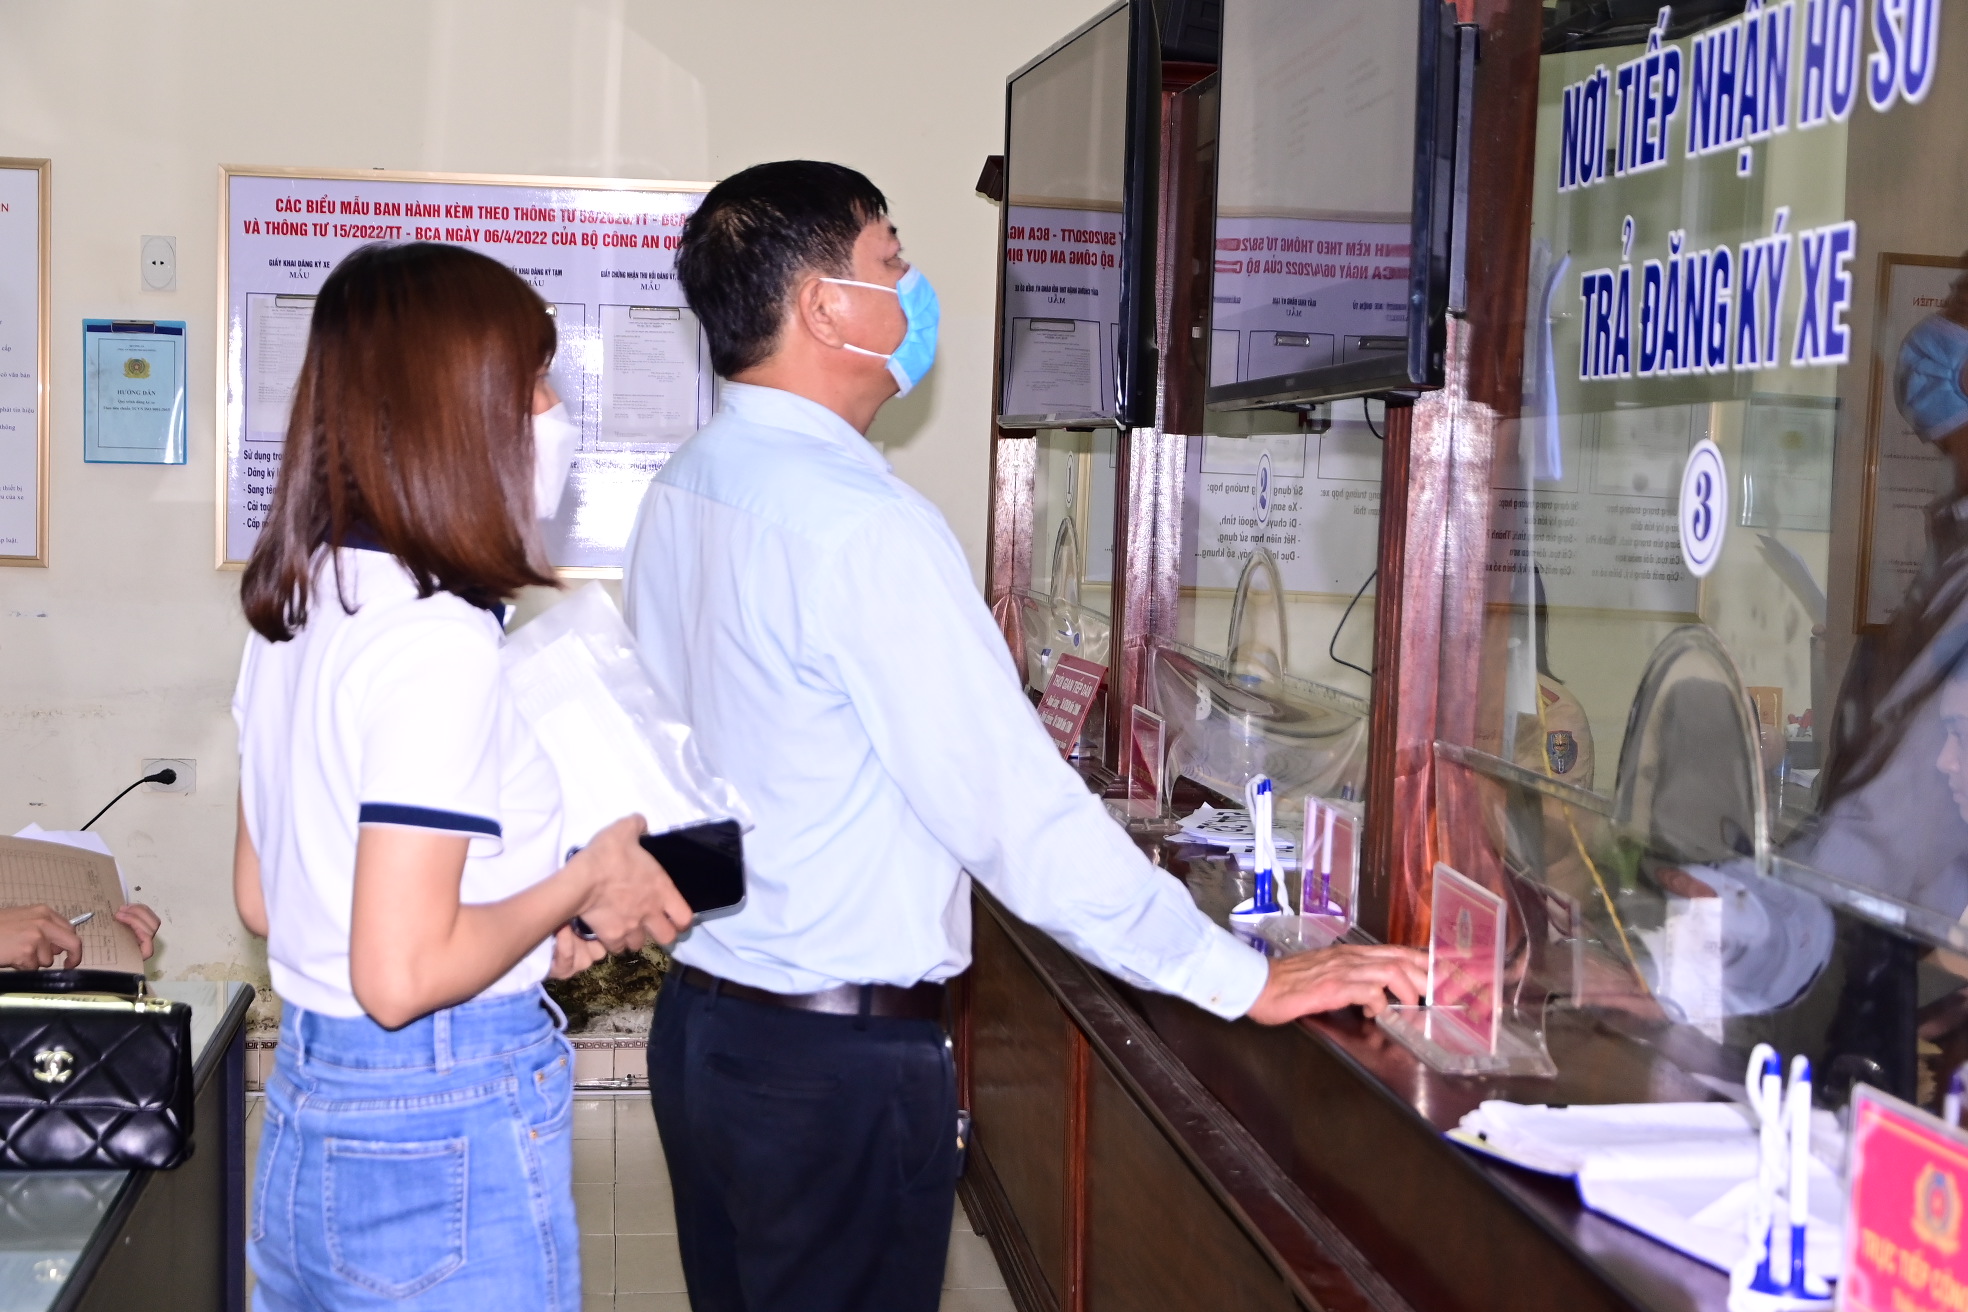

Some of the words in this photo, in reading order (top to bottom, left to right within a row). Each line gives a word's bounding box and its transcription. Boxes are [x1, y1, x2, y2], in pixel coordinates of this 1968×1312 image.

[1558, 63, 1611, 192] NƠI
[1615, 5, 1683, 178] TIẾP
[1685, 0, 1795, 178] NHẬN
[276, 196, 302, 213] CÁC
[306, 194, 336, 214] BIỂU
[340, 195, 370, 216] MẪU
[374, 201, 401, 217] BAN
[405, 200, 440, 218] HÀNH
[445, 201, 474, 219] KÈM
[477, 206, 510, 221] THEO
[513, 205, 556, 222] THÔNG
[560, 207, 576, 223] TƯ
[244, 219, 261, 235] VÀ
[264, 218, 308, 237] THÔNG
[311, 221, 330, 238] TƯ
[332, 223, 403, 240] 15/2022/TT
[415, 226, 442, 241] BCA
[445, 227, 480, 243] NGÀY
[484, 228, 548, 245] 06/4/2022
[551, 226, 577, 246] CỦA
[581, 230, 599, 249] BỘ
[602, 230, 637, 248] CÔNG
[641, 234, 660, 249] AN
[663, 235, 685, 251] QU
[283, 259, 296, 268] KHAI
[323, 261, 330, 269] XE
[518, 267, 530, 275] KHAI
[289, 269, 310, 279] MẪU
[640, 280, 661, 290] MẪU
[1579, 214, 1633, 381] TRẢ
[1637, 228, 1733, 377] ĐĂNG
[1733, 206, 1792, 370] KÝ
[1791, 219, 1857, 367] XE
[243, 449, 253, 460] Sử
[254, 450, 271, 463] dụng
[272, 452, 283, 461] tro
[247, 483, 264, 497] Sang
[1259, 466, 1268, 510] 2
[247, 500, 258, 511] Cải
[1693, 470, 1712, 541] 3
[247, 516, 260, 530] Cấp
